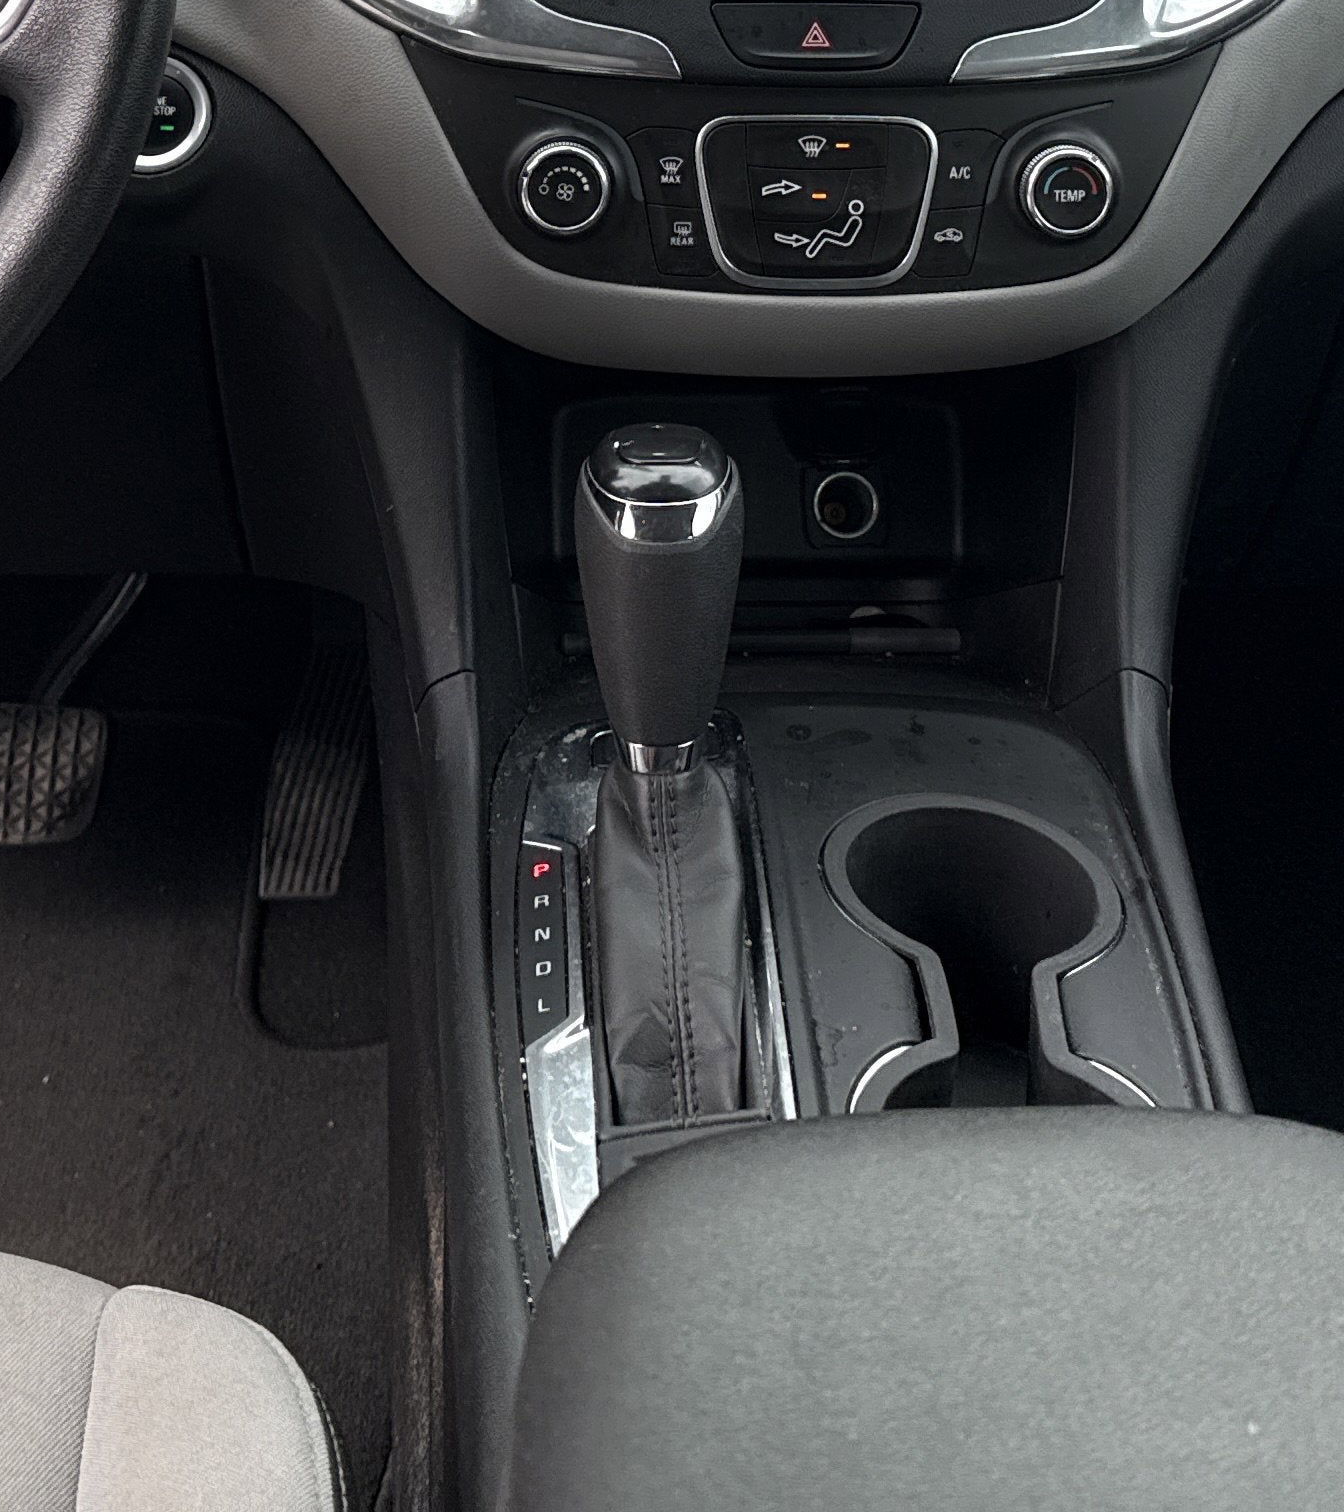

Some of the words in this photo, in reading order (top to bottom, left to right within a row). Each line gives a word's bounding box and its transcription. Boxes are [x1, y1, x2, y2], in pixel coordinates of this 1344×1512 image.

[660, 174, 681, 185] MAX
[948, 165, 972, 180] A/C
[1053, 188, 1087, 203] TEMP
[669, 236, 695, 246] REAR
[532, 862, 551, 878] P
[533, 894, 551, 909] R
[533, 926, 551, 943] N
[534, 960, 552, 977] D
[536, 997, 551, 1014] L
